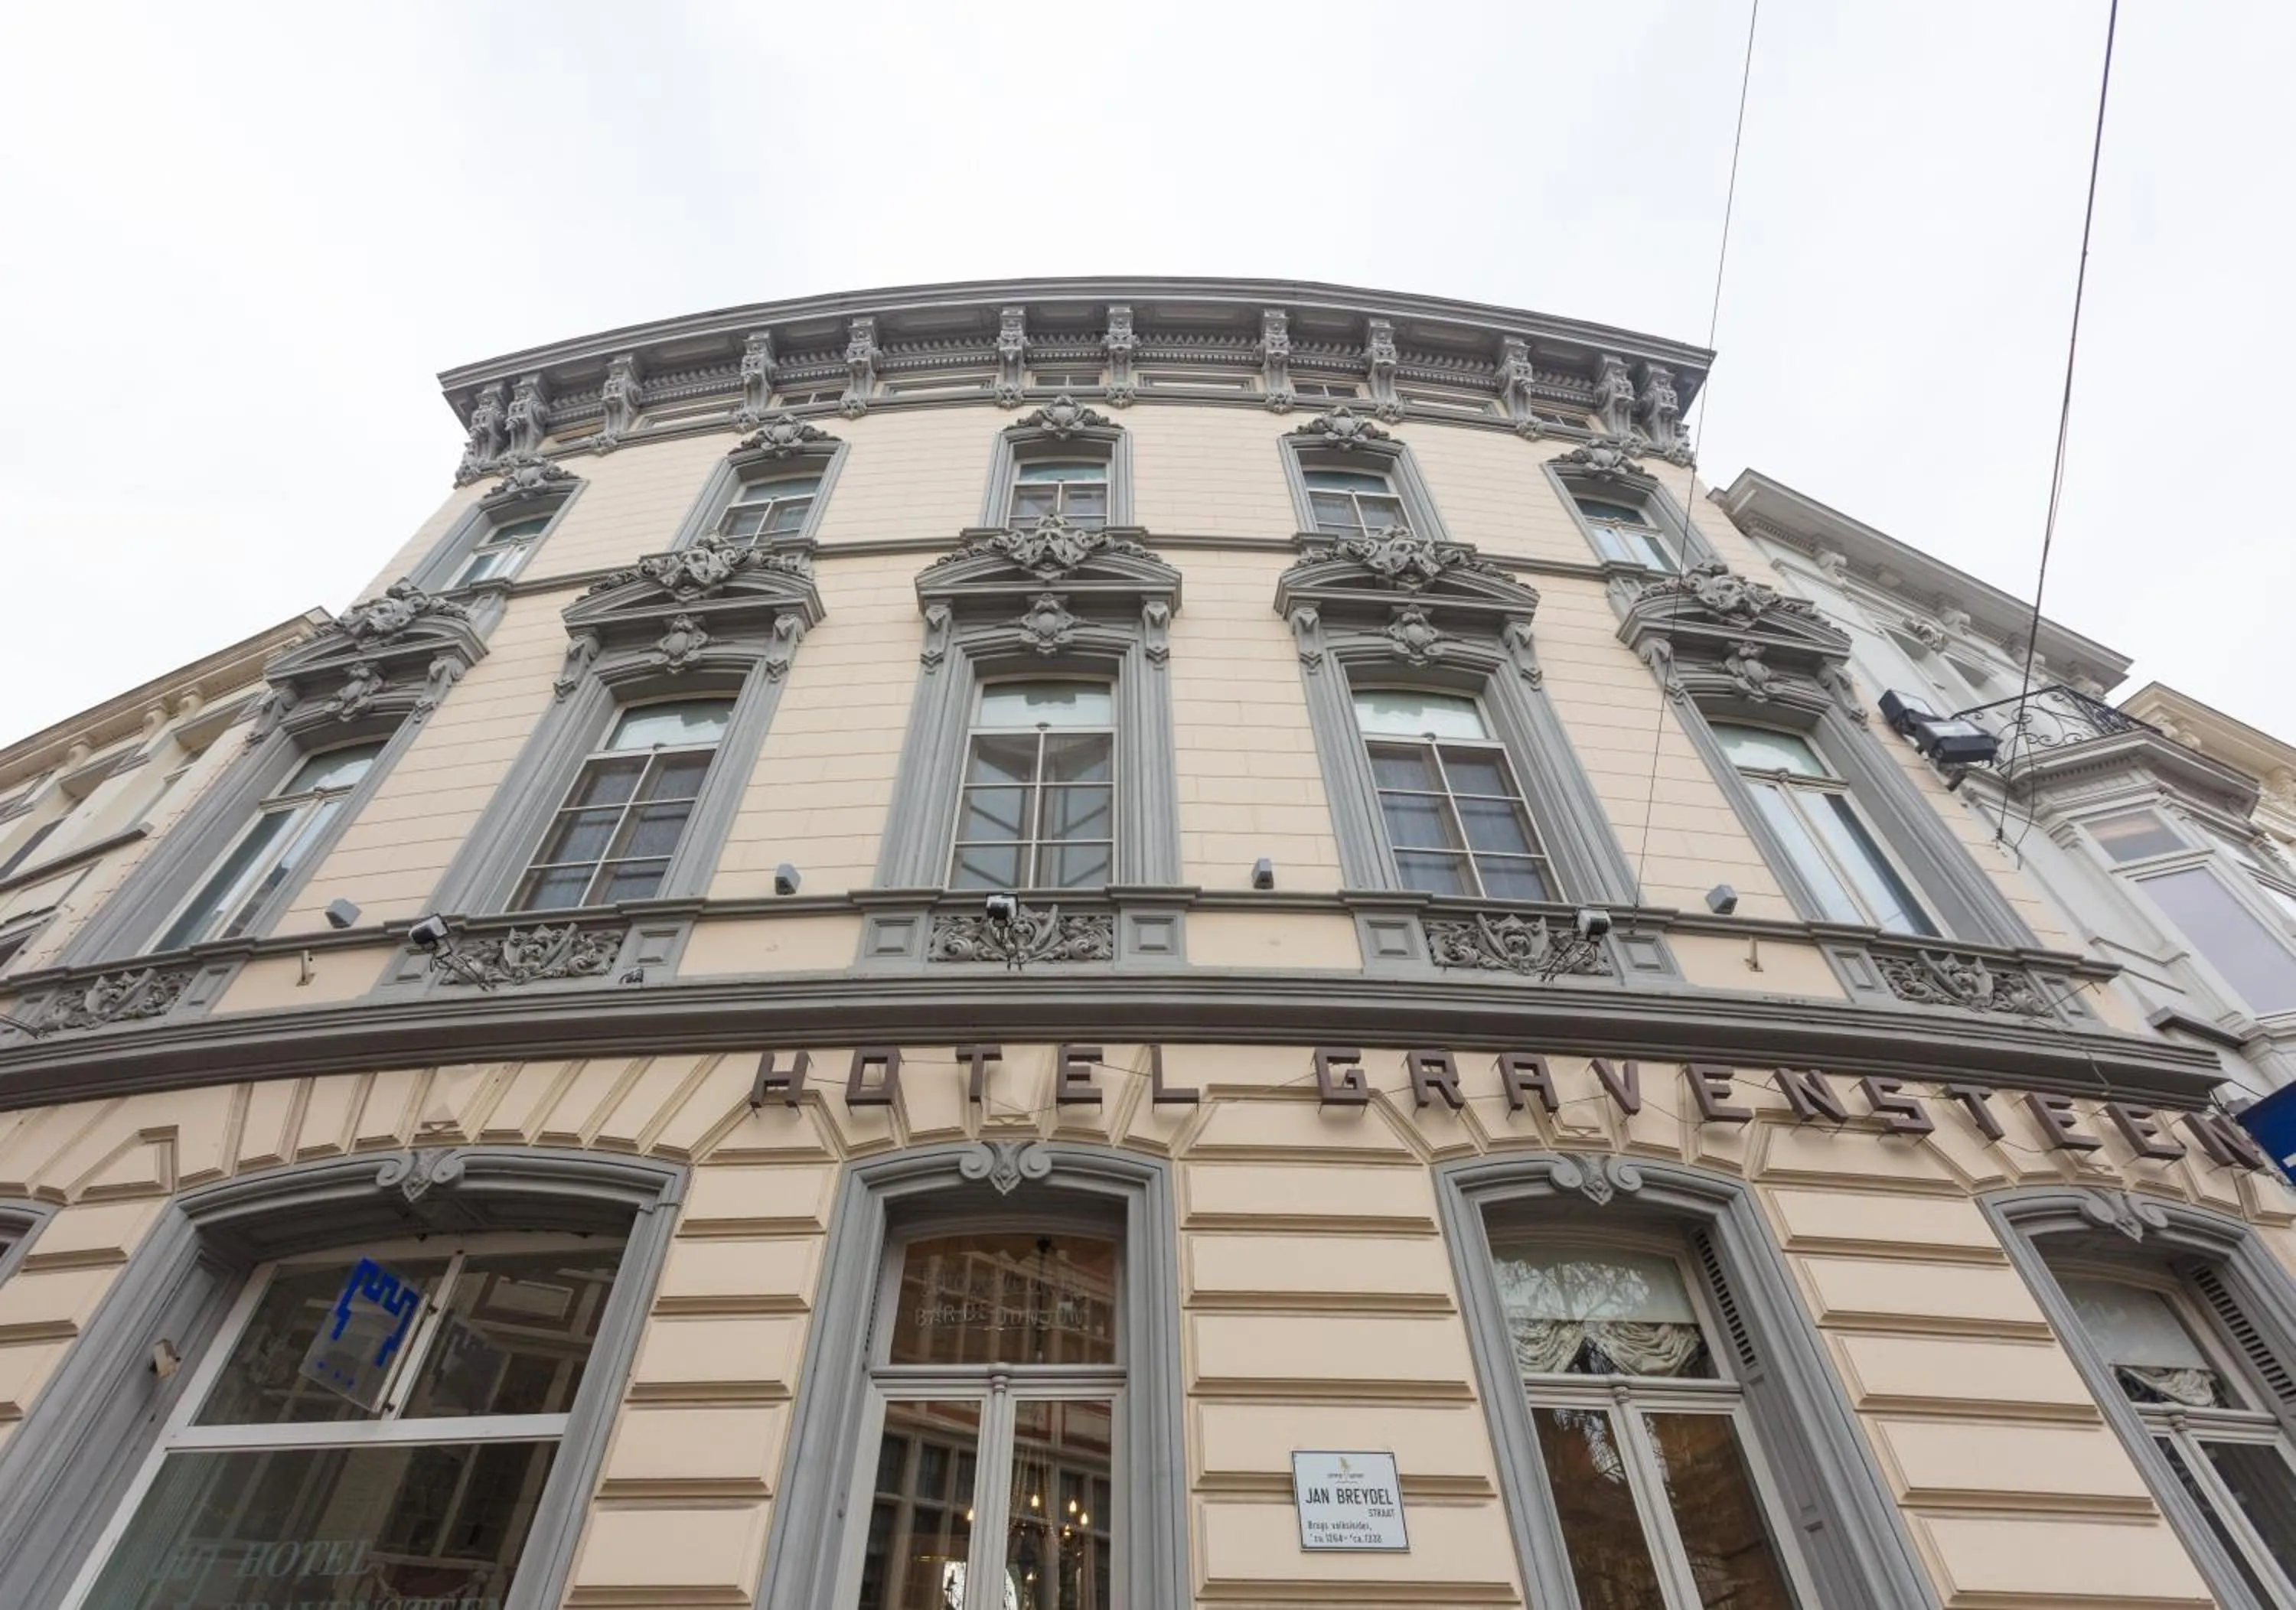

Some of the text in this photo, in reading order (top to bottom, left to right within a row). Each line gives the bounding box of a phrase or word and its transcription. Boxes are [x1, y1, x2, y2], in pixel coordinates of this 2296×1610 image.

[750, 1045, 2266, 1171] HOTEL GRAVENSTEEN
[1306, 1487, 1394, 1505] JAN BREYDEL
[1368, 1507, 1396, 1518] STRAAT
[237, 1540, 373, 1576] HOTEL
